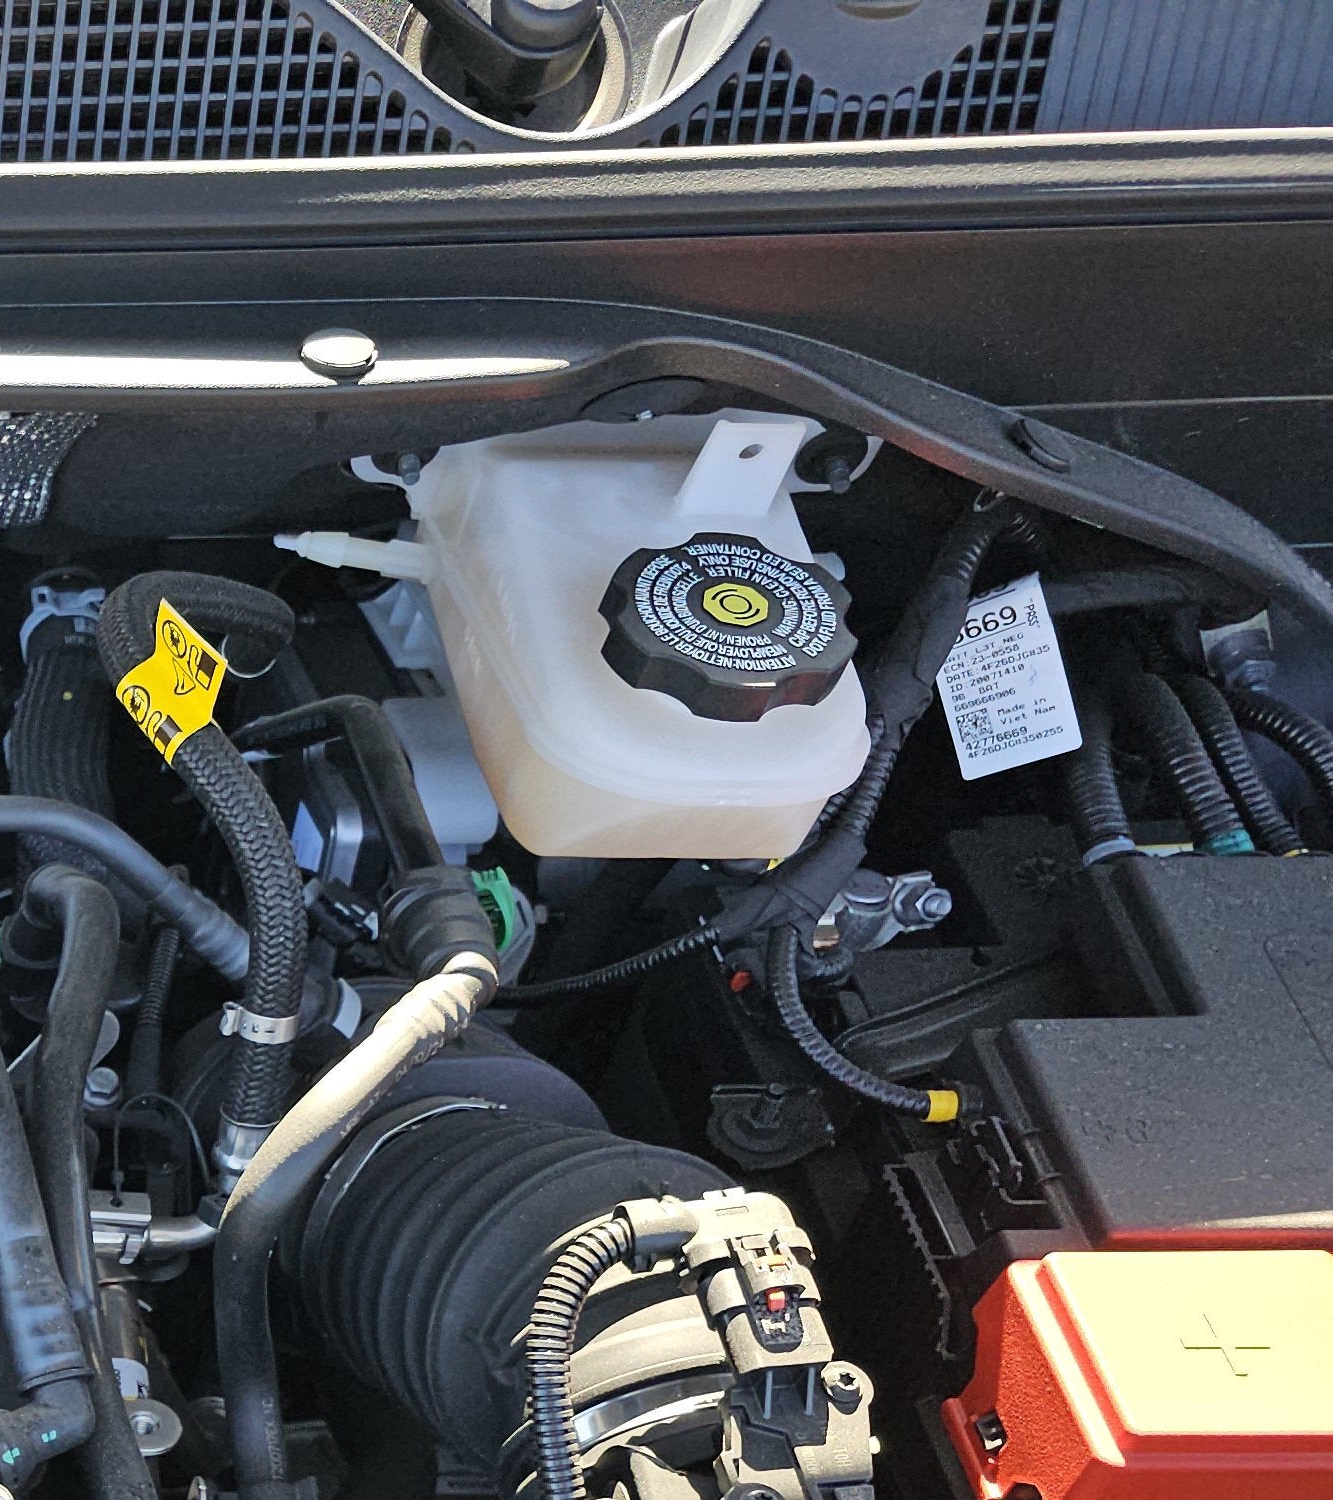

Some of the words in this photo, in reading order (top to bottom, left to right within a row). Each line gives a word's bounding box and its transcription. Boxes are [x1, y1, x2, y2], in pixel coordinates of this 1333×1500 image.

[997, 703, 1026, 717] Made
[1034, 697, 1047, 706] in
[999, 712, 1027, 725] Viet
[1034, 704, 1056, 716] Nam
